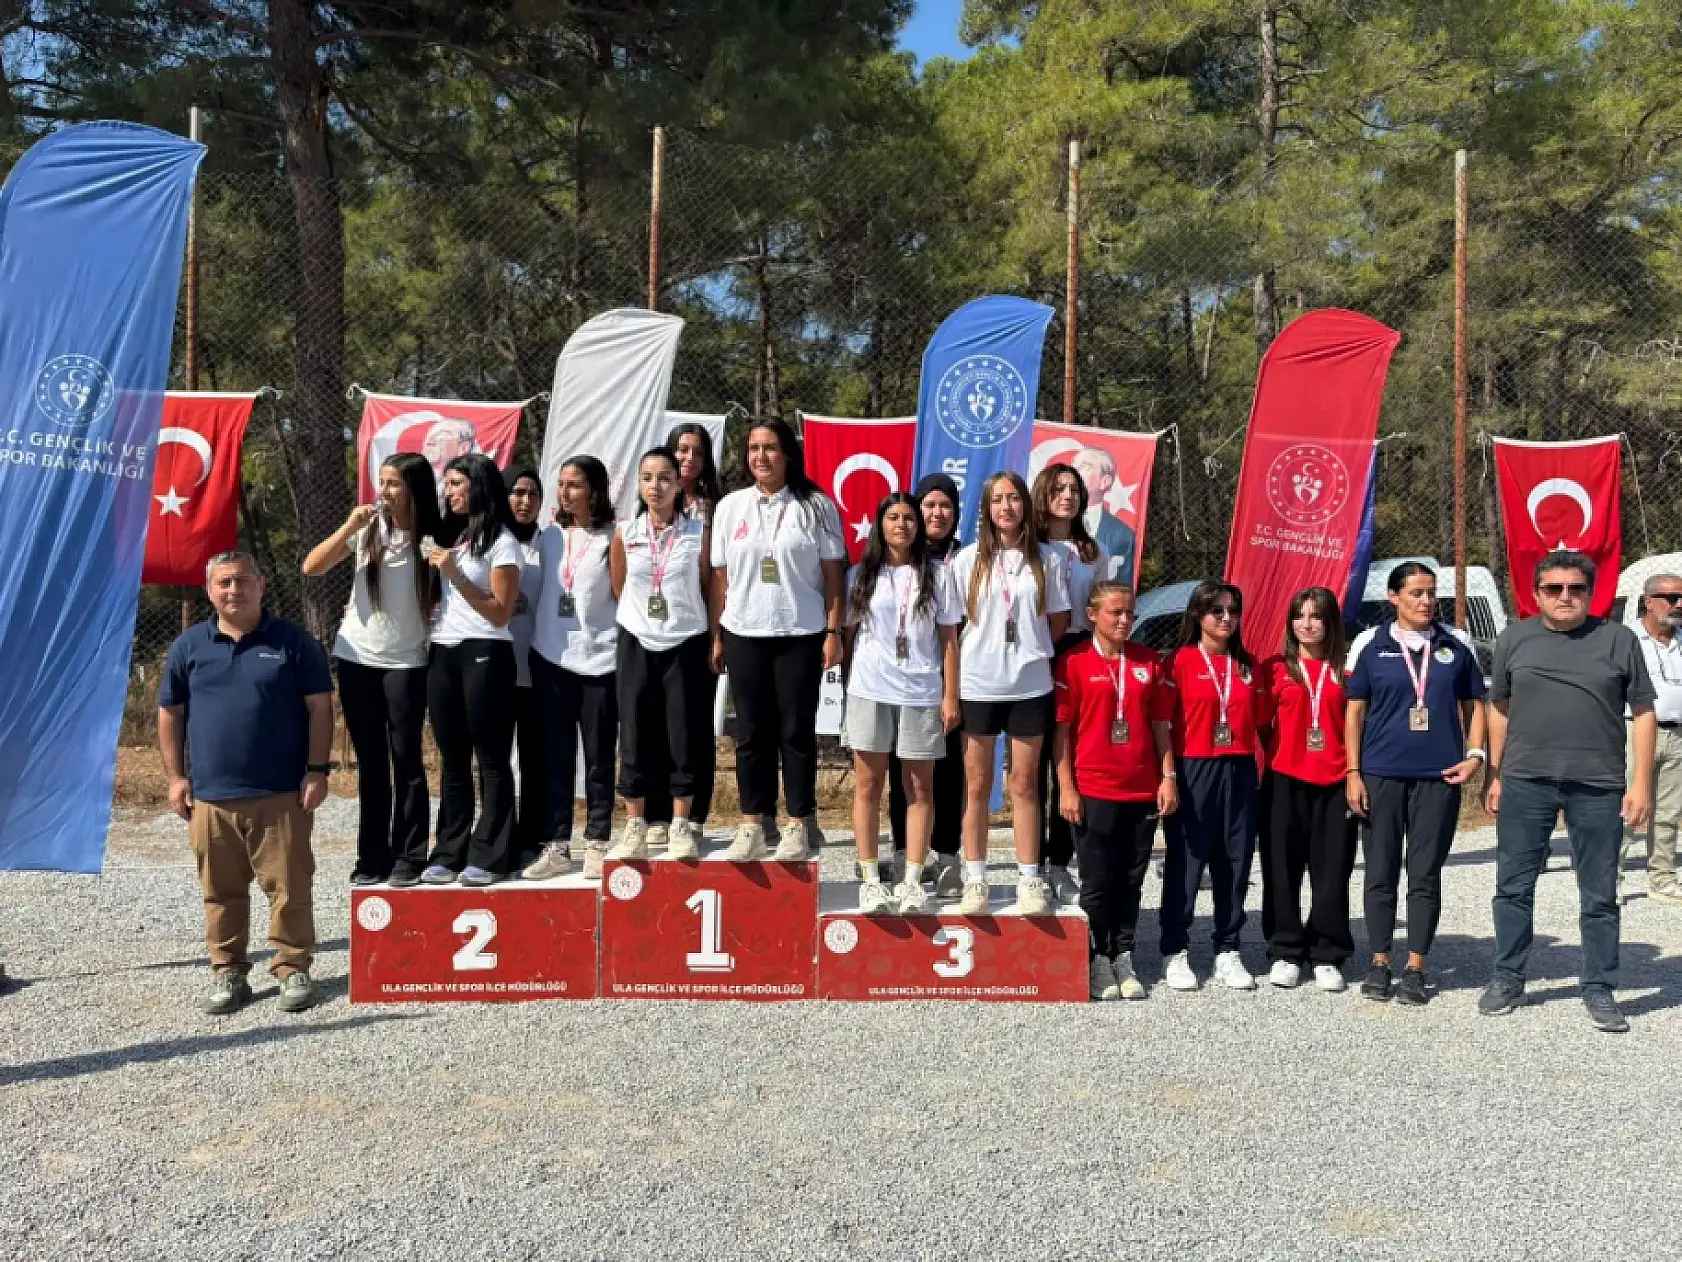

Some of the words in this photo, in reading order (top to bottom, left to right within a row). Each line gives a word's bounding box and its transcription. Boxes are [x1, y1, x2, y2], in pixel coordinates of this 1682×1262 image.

[0, 448, 36, 466] POR
[123, 443, 147, 460] VE
[1249, 535, 1279, 549] SPOR
[1328, 537, 1343, 549] VE
[685, 889, 735, 972] 1
[453, 908, 498, 971] 2
[932, 925, 975, 978] 3
[382, 983, 401, 992] ULA
[445, 983, 457, 992] VE
[459, 983, 484, 992] SPOR
[612, 983, 632, 993] ULA
[678, 984, 690, 993] VE
[692, 984, 719, 993] SPOR
[926, 987, 937, 995] VE
[939, 987, 963, 995] SPOR
